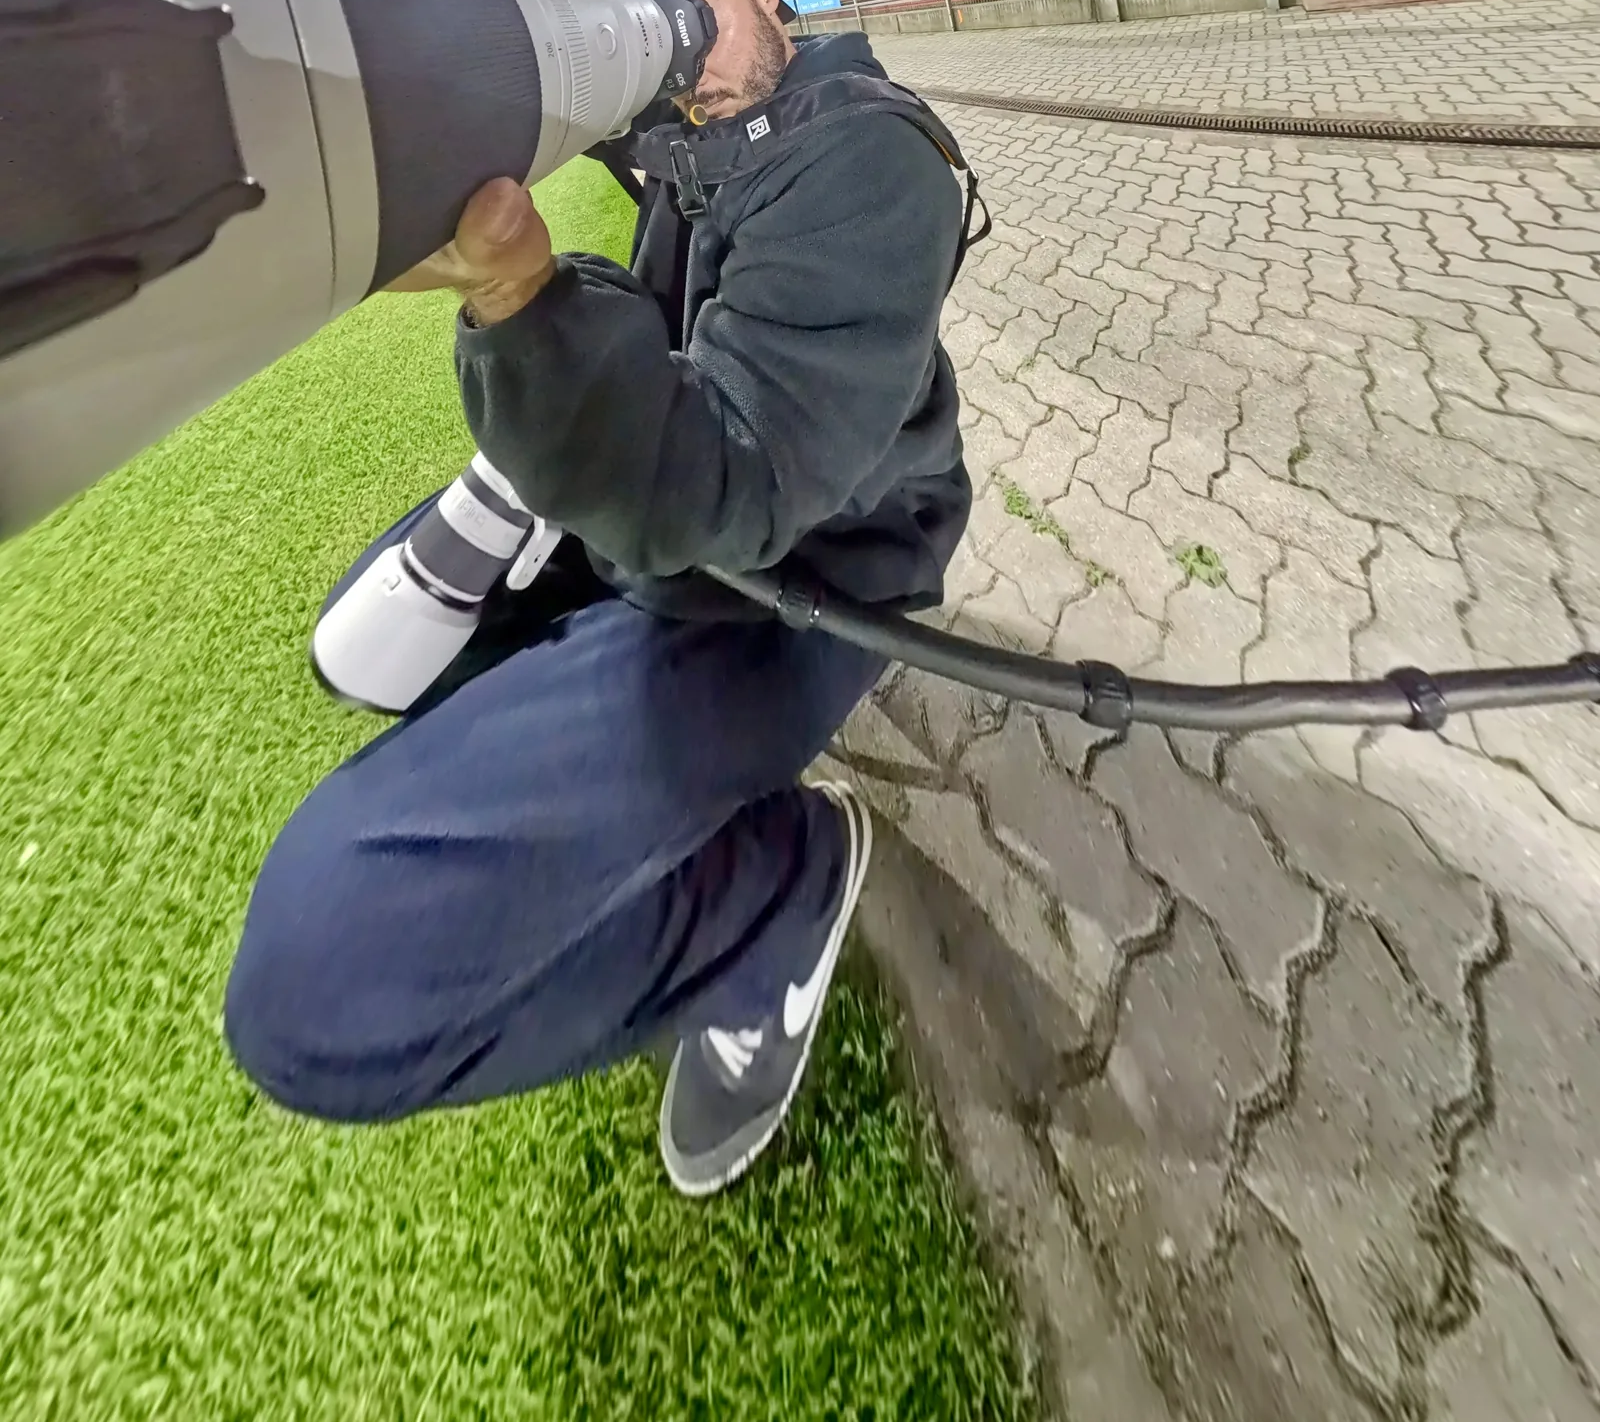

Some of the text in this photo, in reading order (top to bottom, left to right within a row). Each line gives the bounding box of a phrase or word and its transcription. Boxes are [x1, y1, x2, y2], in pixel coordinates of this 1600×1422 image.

[675, 8, 692, 47] Canon
[545, 41, 555, 58] 200
[665, 78, 676, 90] R3
[675, 72, 687, 87] EOS
